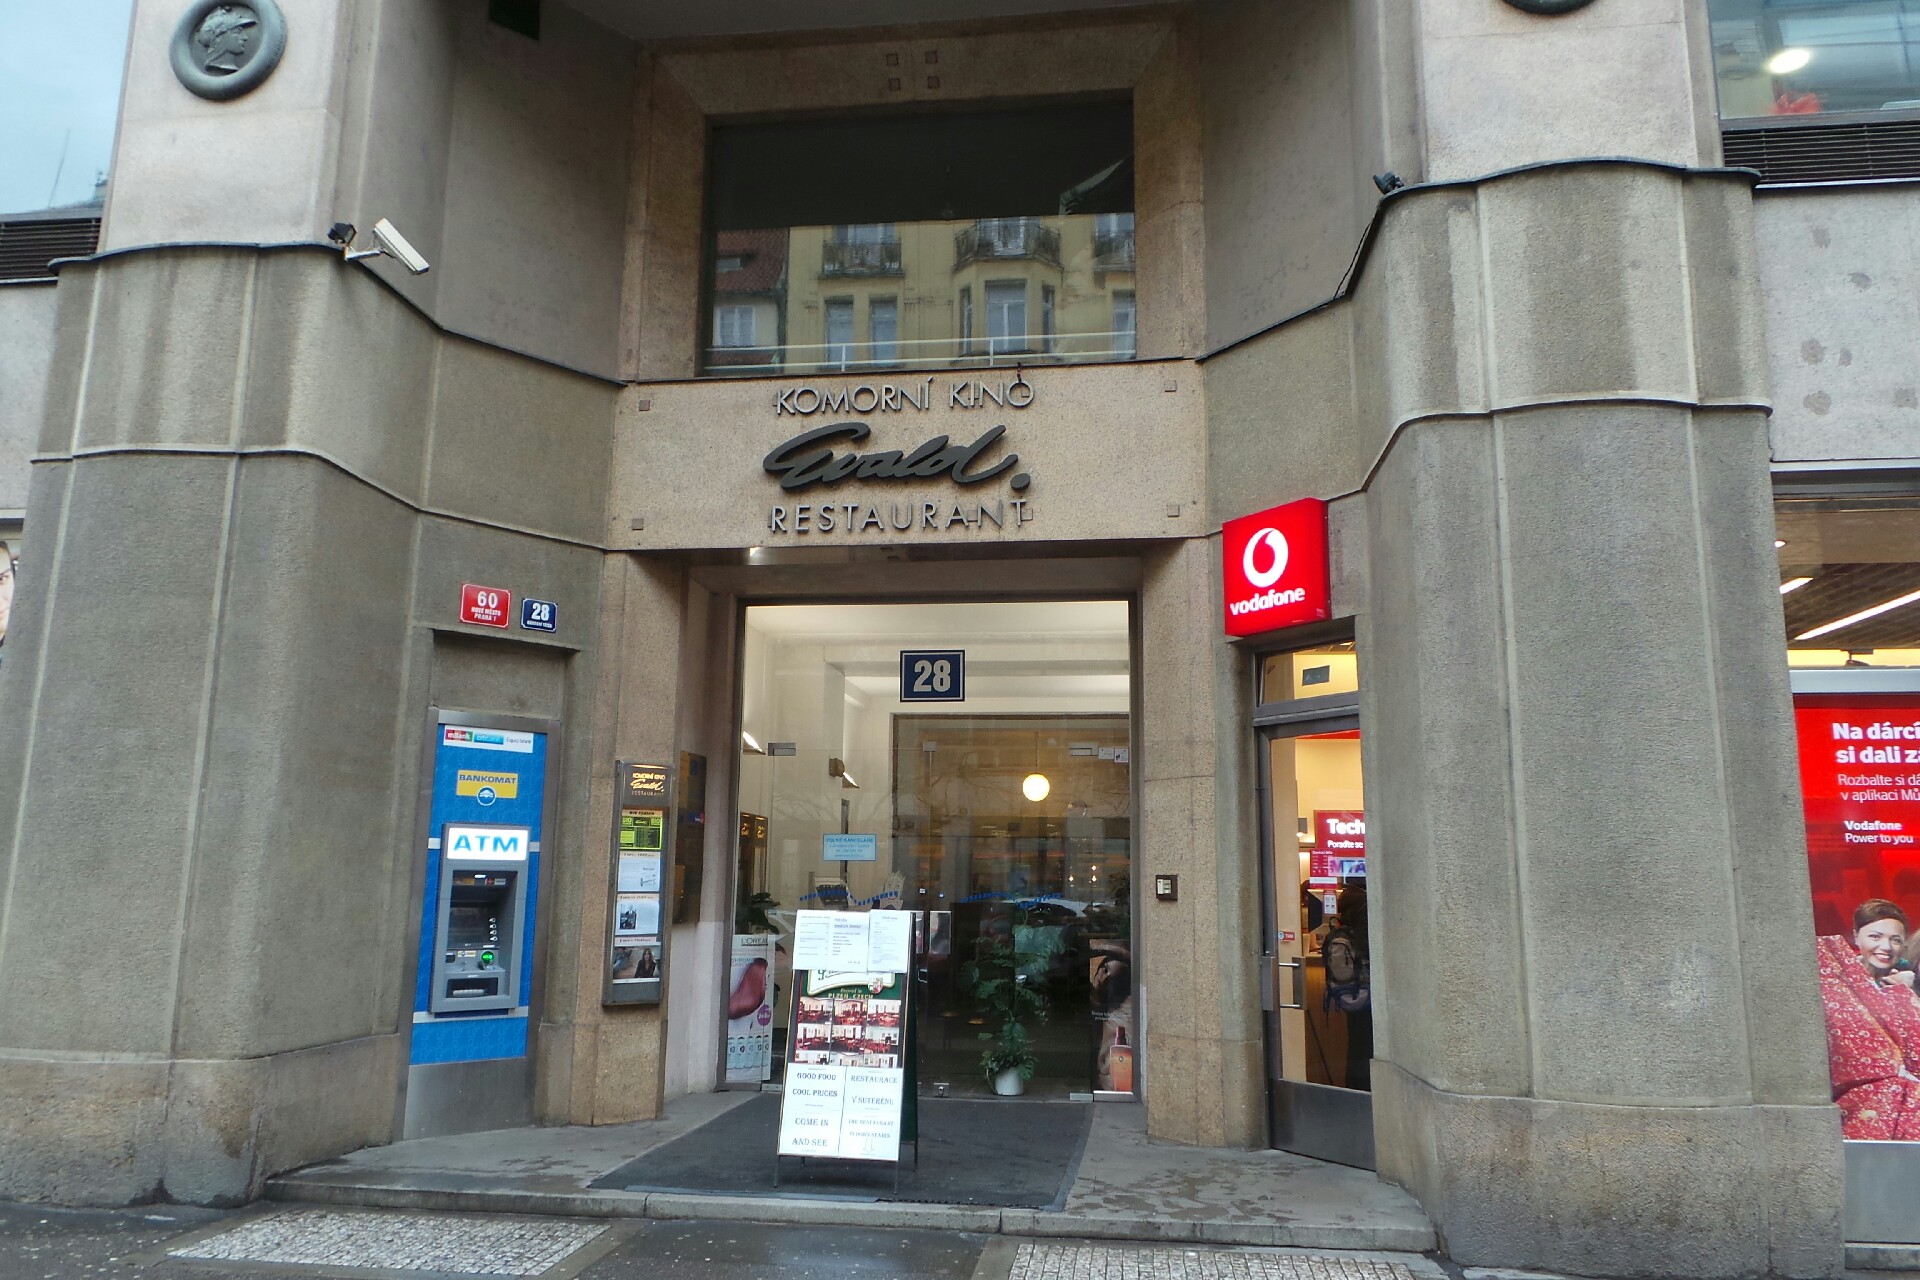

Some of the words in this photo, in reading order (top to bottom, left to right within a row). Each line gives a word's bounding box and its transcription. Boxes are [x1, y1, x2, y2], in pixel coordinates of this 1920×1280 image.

[775, 376, 934, 415] KOMORNÍ
[949, 379, 1034, 409] KINO
[770, 500, 1027, 533] RESTAURANT
[477, 591, 499, 609] 60
[1229, 587, 1306, 616] vodafone
[531, 603, 550, 621] 28
[912, 659, 951, 693] 28
[1832, 722, 1863, 740] Na
[1835, 746, 1856, 763] si
[1860, 745, 1900, 763] dali
[459, 775, 516, 784] BANKOMAT
[1838, 774, 1893, 786] Rozbalte
[1894, 774, 1905, 786] si
[1840, 791, 1848, 800] v
[1852, 788, 1899, 803] aplikaci
[1844, 820, 1902, 831] Vodafone
[453, 835, 519, 852] ATM
[1845, 833, 1879, 843] Power
[1880, 834, 1891, 843] to
[1892, 835, 1914, 845] you
[796, 1072, 816, 1080] GOOD
[818, 1073, 837, 1081] FOOD
[850, 1075, 898, 1084] RESTAURACE
[792, 1088, 811, 1096] COOL
[812, 1089, 838, 1097] PRICES
[795, 1117, 819, 1126] COME
[820, 1118, 829, 1126] IN
[792, 1137, 810, 1146] AND
[811, 1138, 828, 1147] SEE
